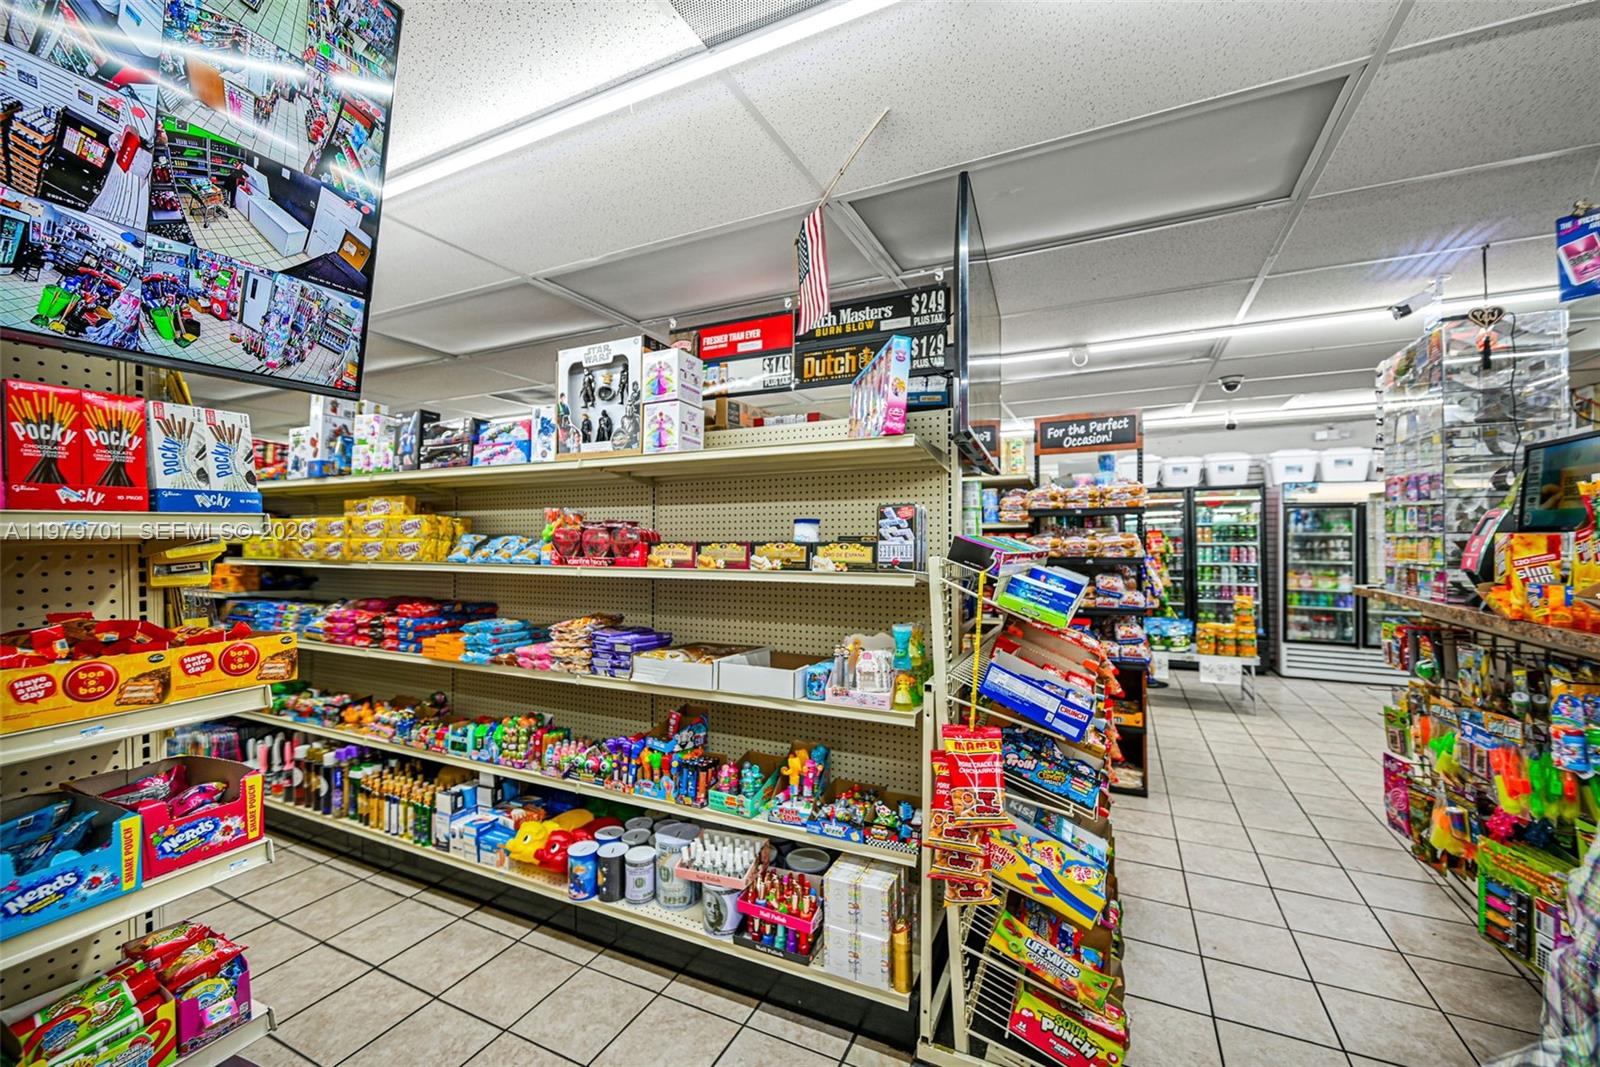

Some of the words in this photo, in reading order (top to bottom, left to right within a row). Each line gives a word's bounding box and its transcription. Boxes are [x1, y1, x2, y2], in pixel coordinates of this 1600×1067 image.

[840, 305, 894, 324] Masters
[913, 316, 930, 326] PLUS
[930, 313, 946, 324] TAX
[703, 334, 728, 346] FRESHER
[729, 331, 745, 342] THAN
[745, 328, 762, 339] EVER
[815, 326, 842, 337] BURN
[845, 320, 875, 332] SLOW
[584, 344, 612, 357] STAR
[584, 354, 611, 365] WARS
[804, 352, 857, 379] Dutch
[912, 358, 929, 369] PLUS
[10, 421, 77, 446] Pocky
[1047, 427, 1065, 439] For
[1068, 423, 1085, 435] the
[1089, 417, 1130, 432] Perfect
[84, 428, 143, 451] Pocky
[1063, 431, 1112, 447] Occasion!
[158, 437, 182, 476] Pocky
[211, 442, 233, 478] Pocky
[78, 670, 104, 680] bon
[188, 665, 206, 674] day
[230, 662, 249, 671] bon
[20, 690, 45, 701] day
[26, 681, 53, 693] nice
[79, 685, 105, 695] bon
[1060, 705, 1087, 722] CRUNCH
[1006, 753, 1037, 770] Trolli
[123, 827, 133, 856] POUCH
[124, 857, 134, 883] SHARE
[759, 910, 771, 918] Nail
[771, 914, 787, 924] Polish
[1054, 1014, 1088, 1040] SOUR
[1041, 1015, 1097, 1059] PUNCH
